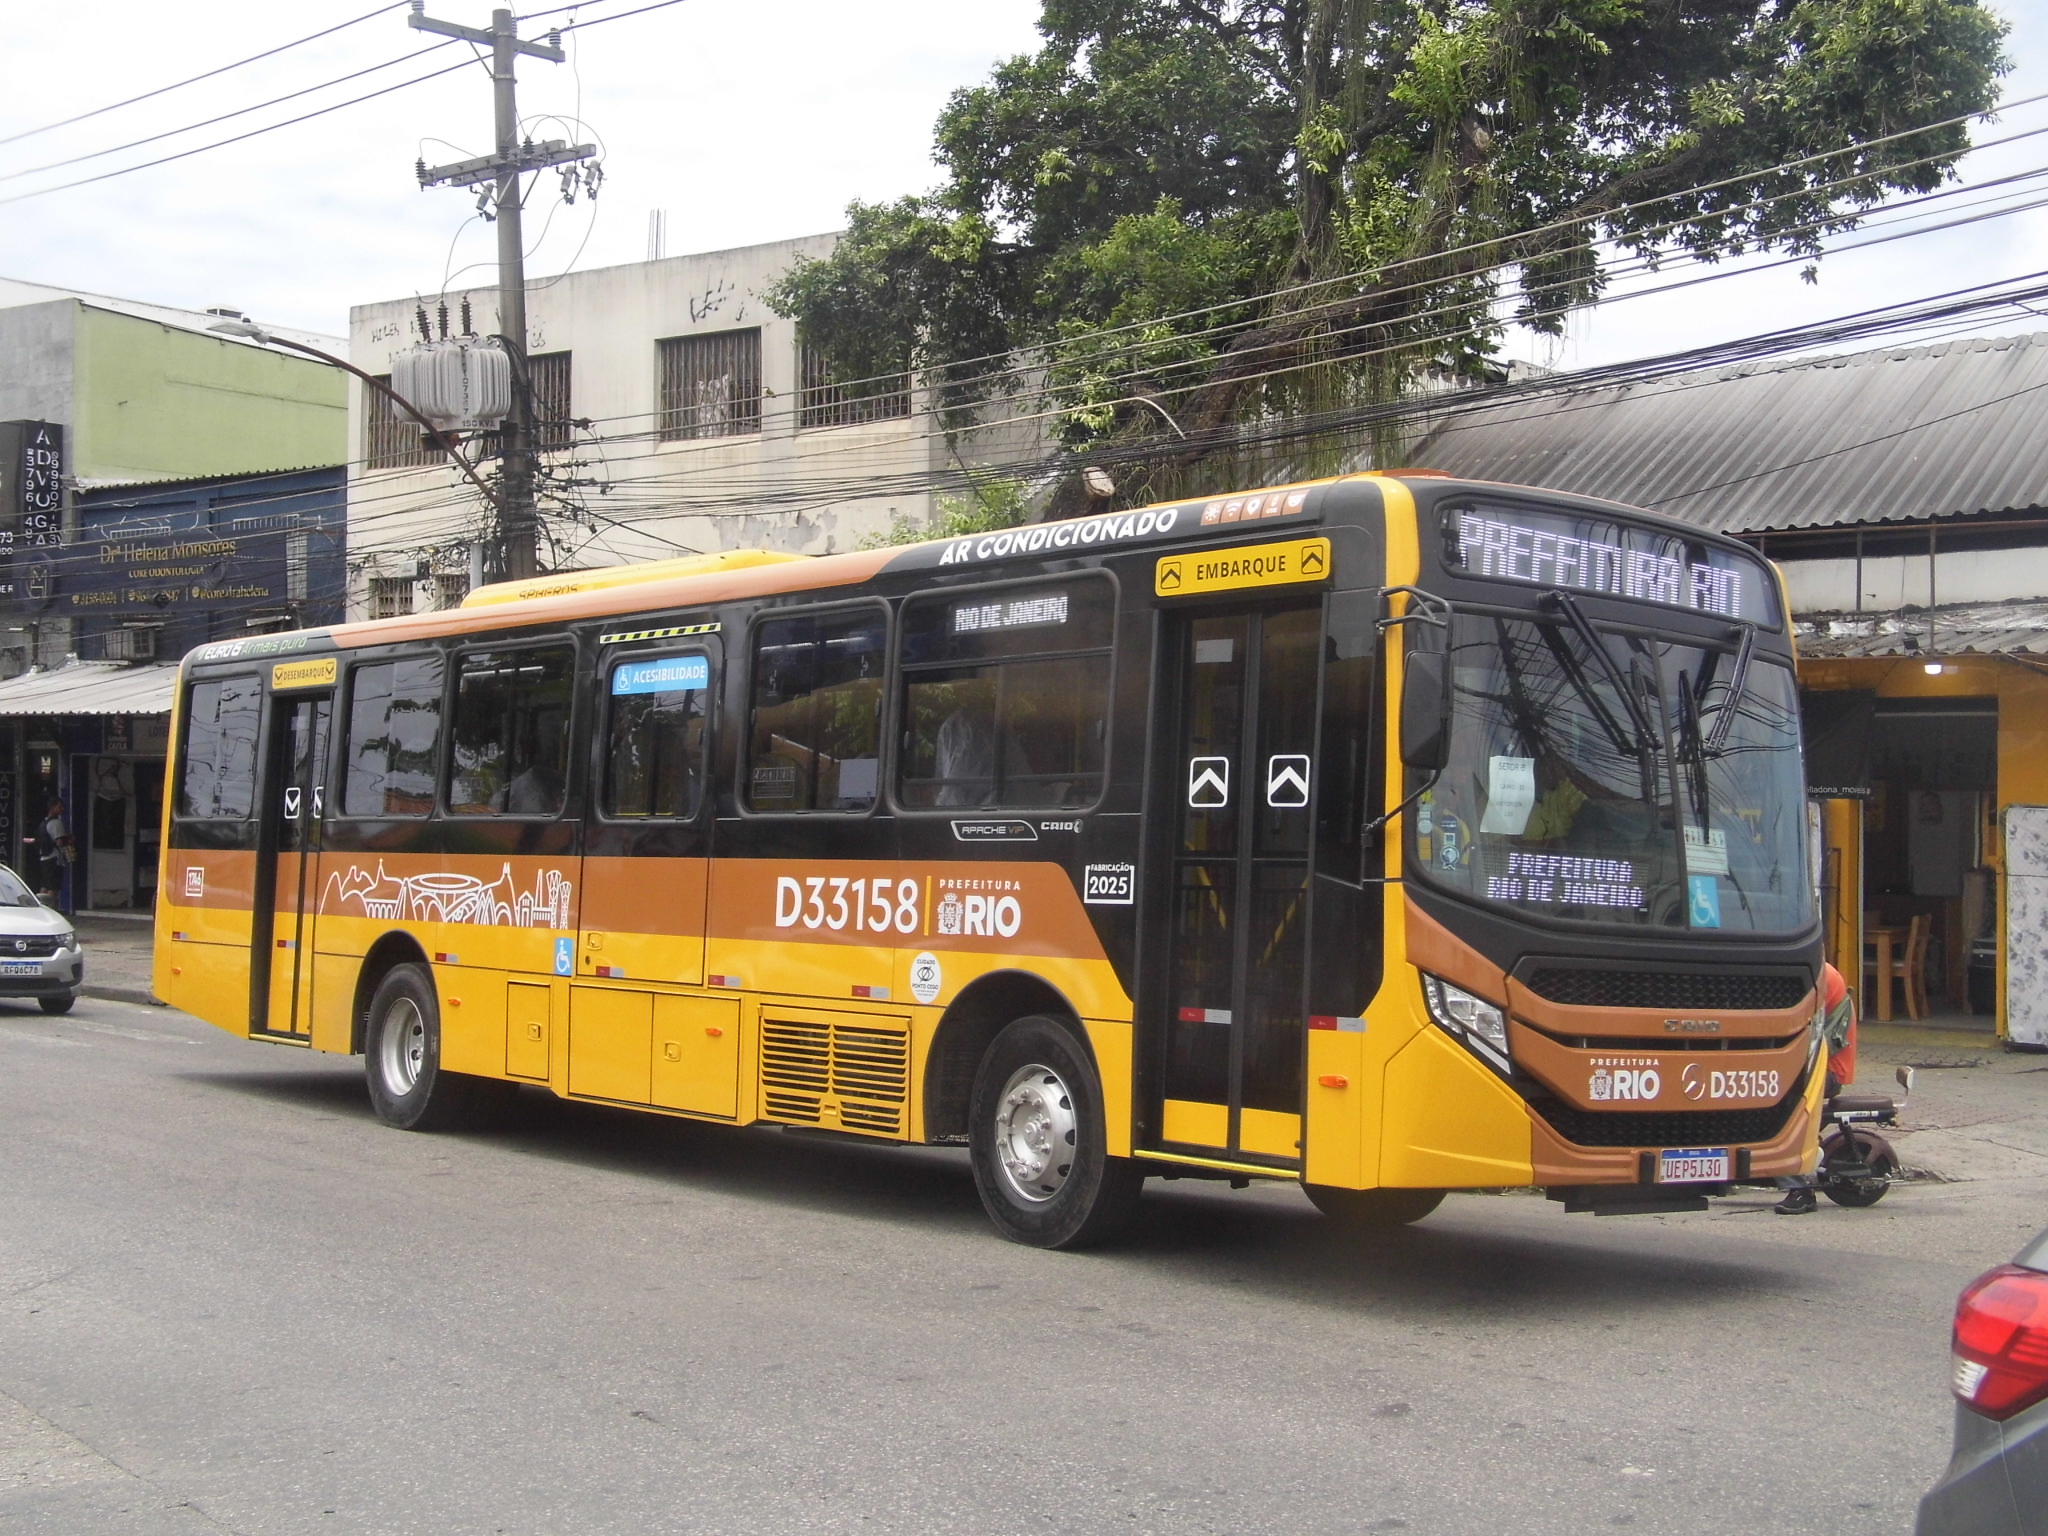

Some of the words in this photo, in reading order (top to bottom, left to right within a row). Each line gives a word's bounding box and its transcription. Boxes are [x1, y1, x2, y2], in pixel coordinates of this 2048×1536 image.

[939, 540, 972, 566] AR
[976, 508, 1178, 559] CONDICIONADO
[124, 543, 169, 563] Helena
[172, 541, 237, 560] Monsores
[1196, 555, 1287, 580] EMBARQUE
[1459, 515, 1680, 605] PREFEITURA
[1690, 563, 1741, 618] RIO
[955, 608, 980, 632] RIO
[981, 604, 1002, 628] DE
[1003, 596, 1069, 625] JANEIRO
[279, 637, 308, 654] puro
[283, 666, 325, 680] DESEMBARQUE
[961, 826, 1007, 834] APACHE
[1008, 825, 1025, 834] VIP
[1040, 821, 1074, 831] CAIO
[1090, 862, 1130, 873] FABRICAÇÃO
[1507, 852, 1633, 883] PREFEITURA
[939, 879, 1021, 891] PREFEITURA
[1089, 876, 1128, 895] 2025
[1487, 876, 1523, 900] RIO
[1527, 879, 1554, 902] DE
[1559, 881, 1643, 907] JANEIRO
[775, 876, 919, 934] D33158
[964, 895, 1021, 938] RIO
[1589, 1058, 1660, 1066] PREFEITURA
[1613, 1069, 1661, 1100] RIO
[1710, 1070, 1779, 1098] D33158
